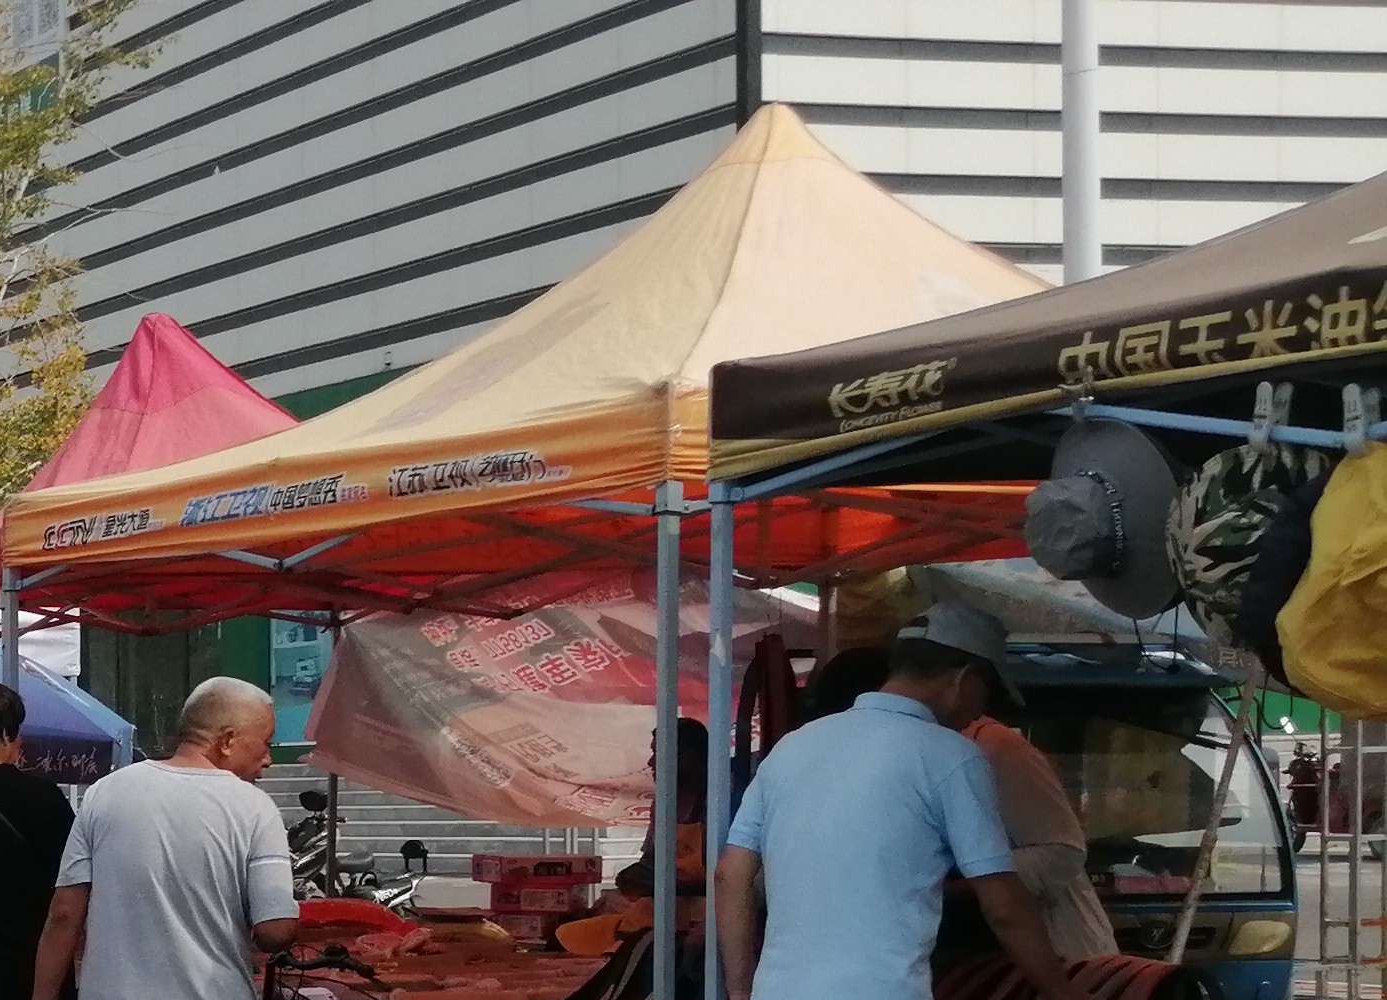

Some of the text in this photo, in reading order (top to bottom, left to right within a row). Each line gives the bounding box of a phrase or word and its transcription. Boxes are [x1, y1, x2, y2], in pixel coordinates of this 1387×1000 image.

[1058, 283, 1387, 384] 中国玉米油
[828, 358, 955, 418] 长寿花
[43, 514, 97, 550] CCTV
